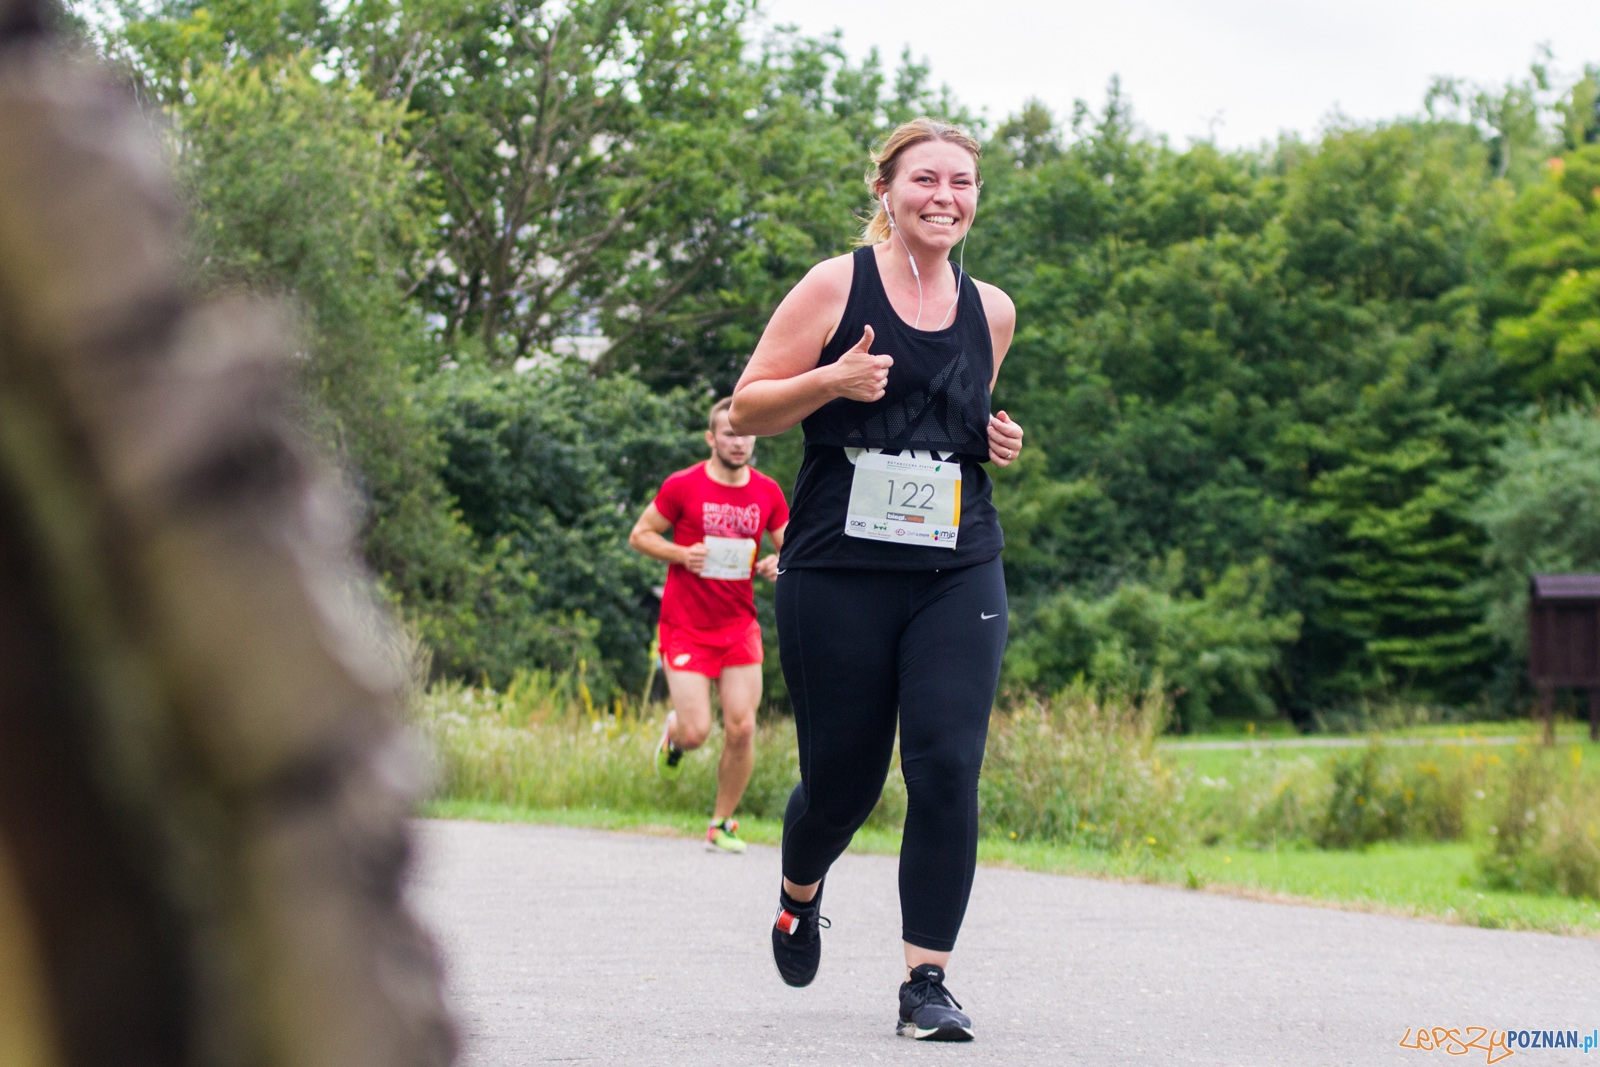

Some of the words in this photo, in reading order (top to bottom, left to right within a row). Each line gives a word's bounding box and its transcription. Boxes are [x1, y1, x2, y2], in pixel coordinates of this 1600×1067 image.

[888, 479, 935, 510] 122
[703, 513, 760, 535] SZPIKU
[940, 530, 956, 539] mjp
